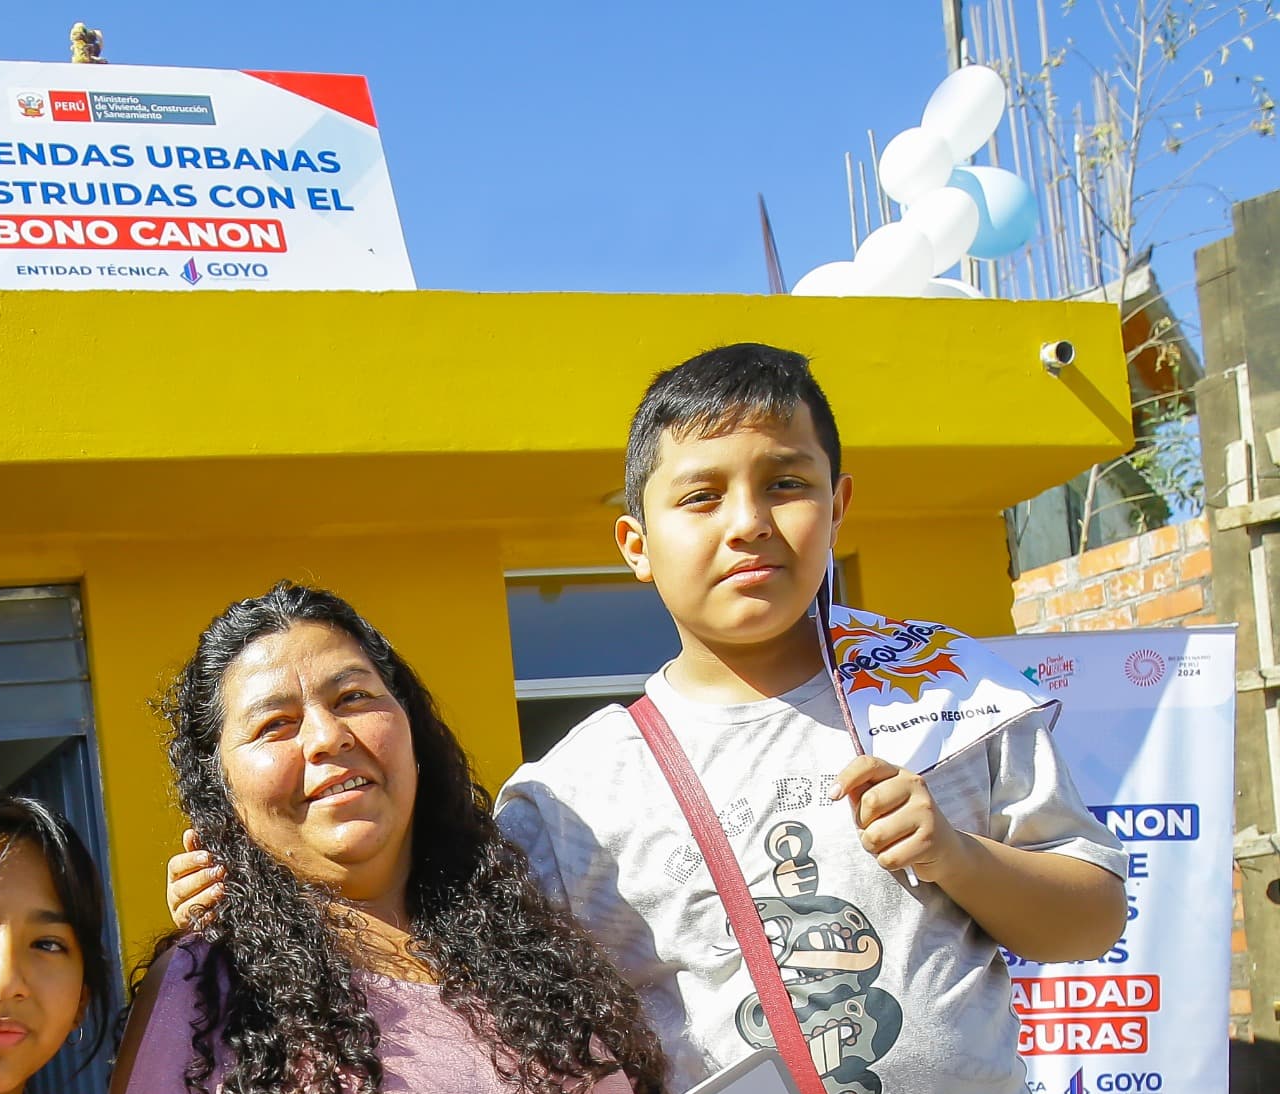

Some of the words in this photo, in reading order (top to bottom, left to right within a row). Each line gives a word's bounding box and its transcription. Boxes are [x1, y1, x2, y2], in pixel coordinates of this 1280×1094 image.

[55, 99, 86, 112] PERÚ
[93, 95, 140, 104] Ministerio
[95, 103, 107, 111] de
[151, 104, 209, 114] Construcción
[104, 110, 163, 120] Saneamiento
[147, 145, 341, 173] URBANAS
[208, 185, 296, 210] CON
[308, 188, 355, 211] EL
[130, 222, 281, 248] CANON
[16, 265, 92, 275] ENTIDAD
[97, 264, 169, 277] TÉCNICA
[207, 262, 269, 277] GOYO
[1177, 669, 1201, 677] 2024
[868, 712, 938, 736] GOBIERNO
[941, 704, 1001, 722] REGIONAL
[1107, 809, 1192, 837] NON
[1012, 980, 1153, 1010] ALIDAD
[1017, 1021, 1143, 1052] GURAS
[1096, 1072, 1163, 1092] GOYO
